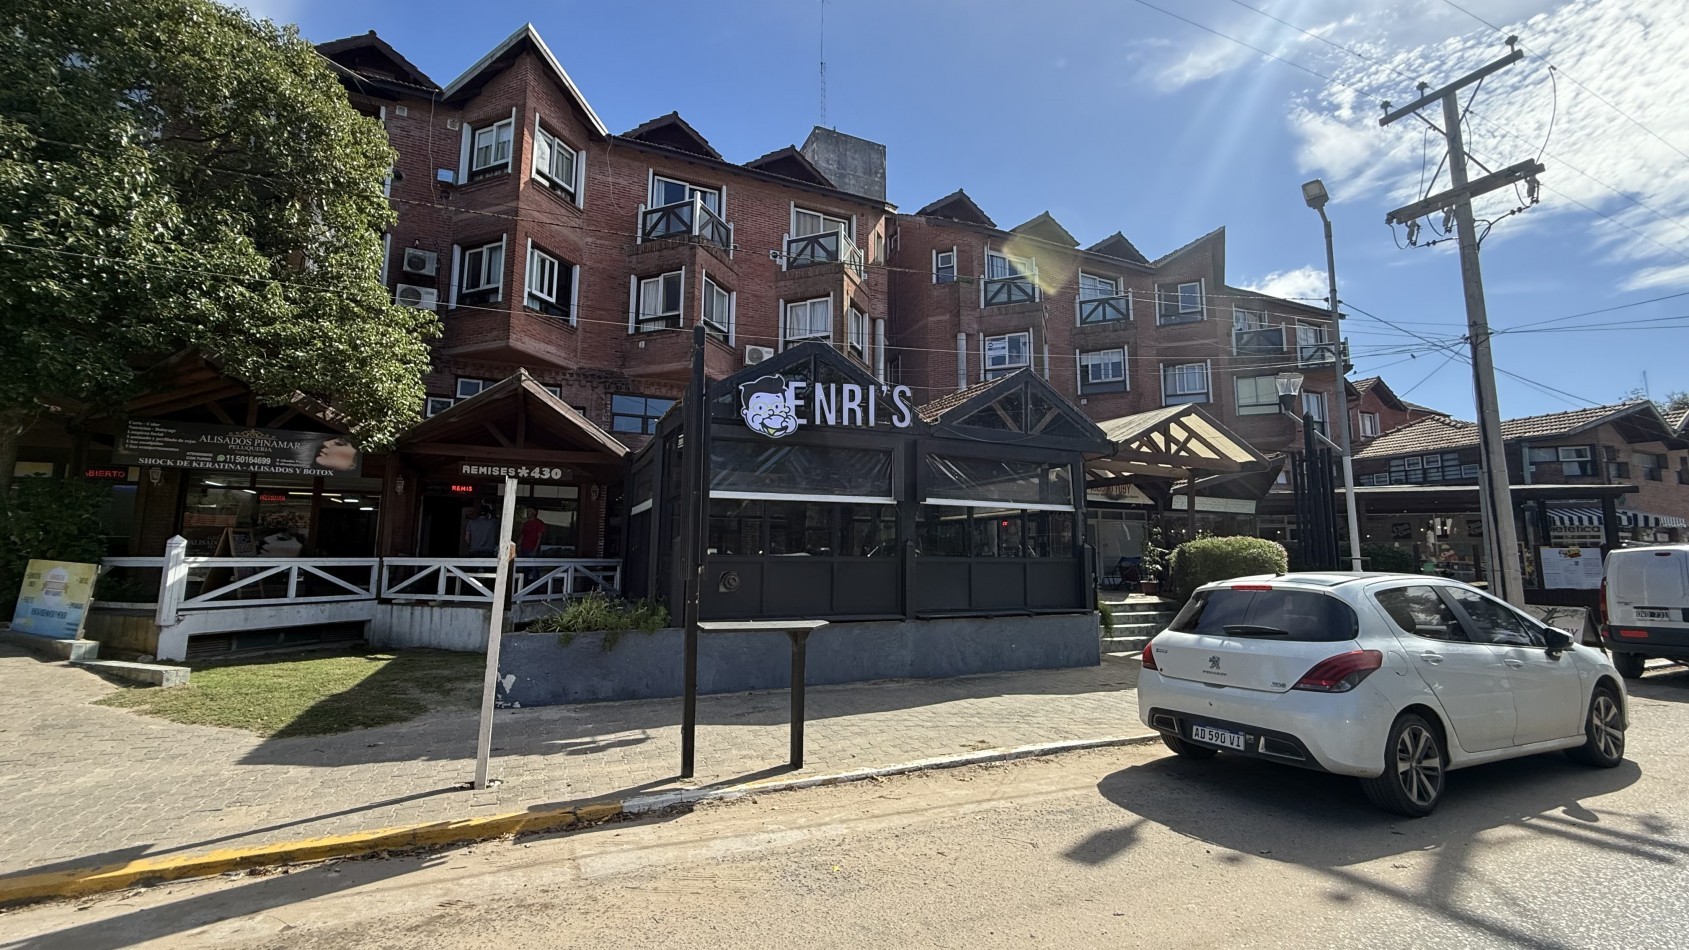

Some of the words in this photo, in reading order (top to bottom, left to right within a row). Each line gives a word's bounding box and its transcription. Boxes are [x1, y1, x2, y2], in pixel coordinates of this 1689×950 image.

[199, 434, 251, 446] ALISADOS
[254, 440, 301, 449] PINAMAR
[138, 458, 174, 466] SHOCK
[192, 461, 241, 470] KERATINA
[248, 465, 293, 474] ALISADOS
[303, 468, 334, 476] BOTOX
[462, 465, 516, 476] REMISES
[530, 466, 562, 479] 430
[1194, 727, 1206, 739] AD
[1208, 730, 1226, 744] 590
[1230, 735, 1241, 747] VI
